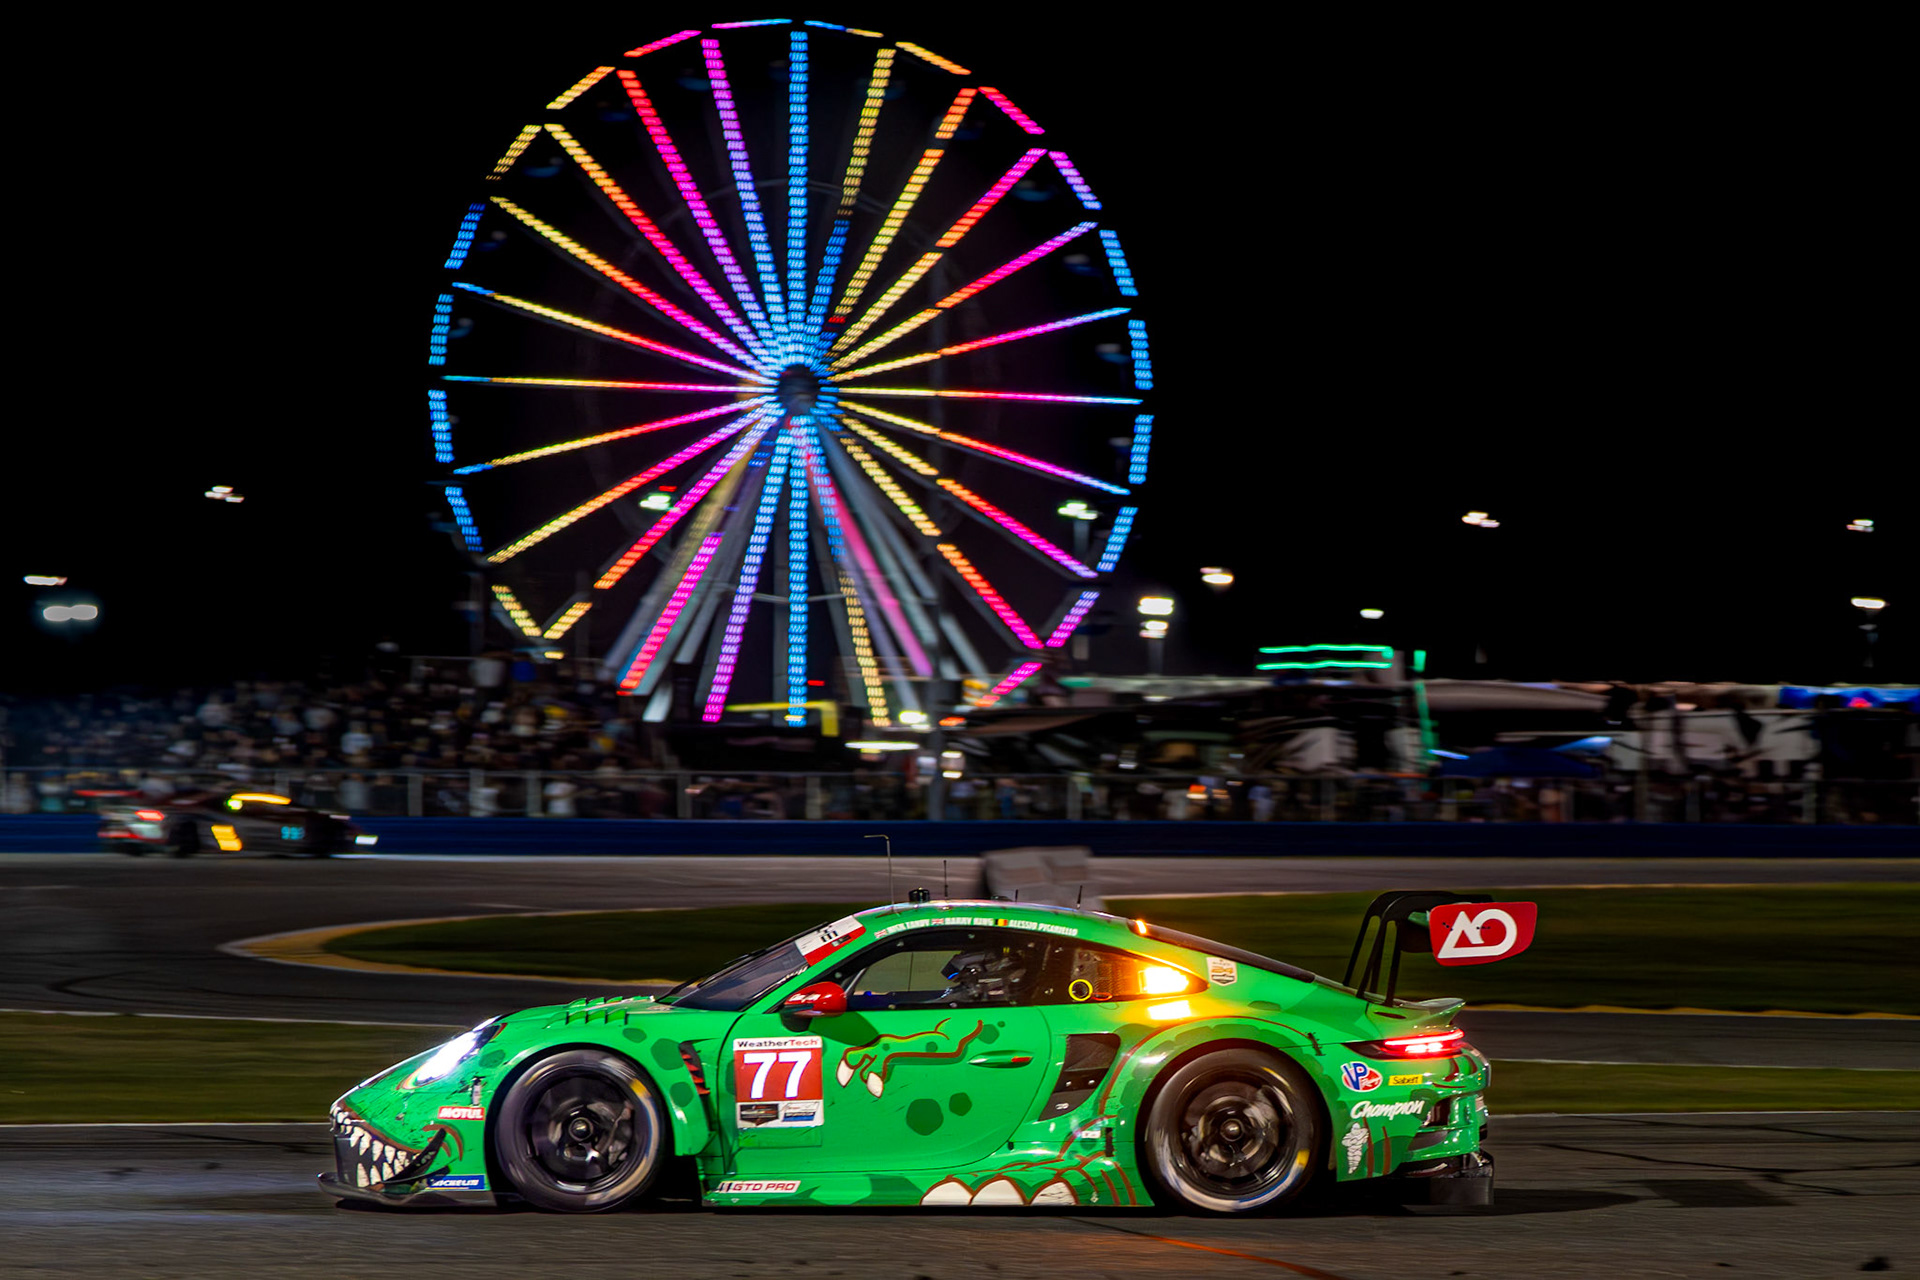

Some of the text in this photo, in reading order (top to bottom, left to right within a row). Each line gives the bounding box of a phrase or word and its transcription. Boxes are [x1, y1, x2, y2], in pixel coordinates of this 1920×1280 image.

[737, 1038, 818, 1048] WeatherTech
[743, 1051, 812, 1099] 77
[1341, 1061, 1369, 1091] VP
[438, 1107, 483, 1119] MOTUL
[1350, 1100, 1425, 1121] Champion
[732, 1183, 796, 1192] GTD PRO
